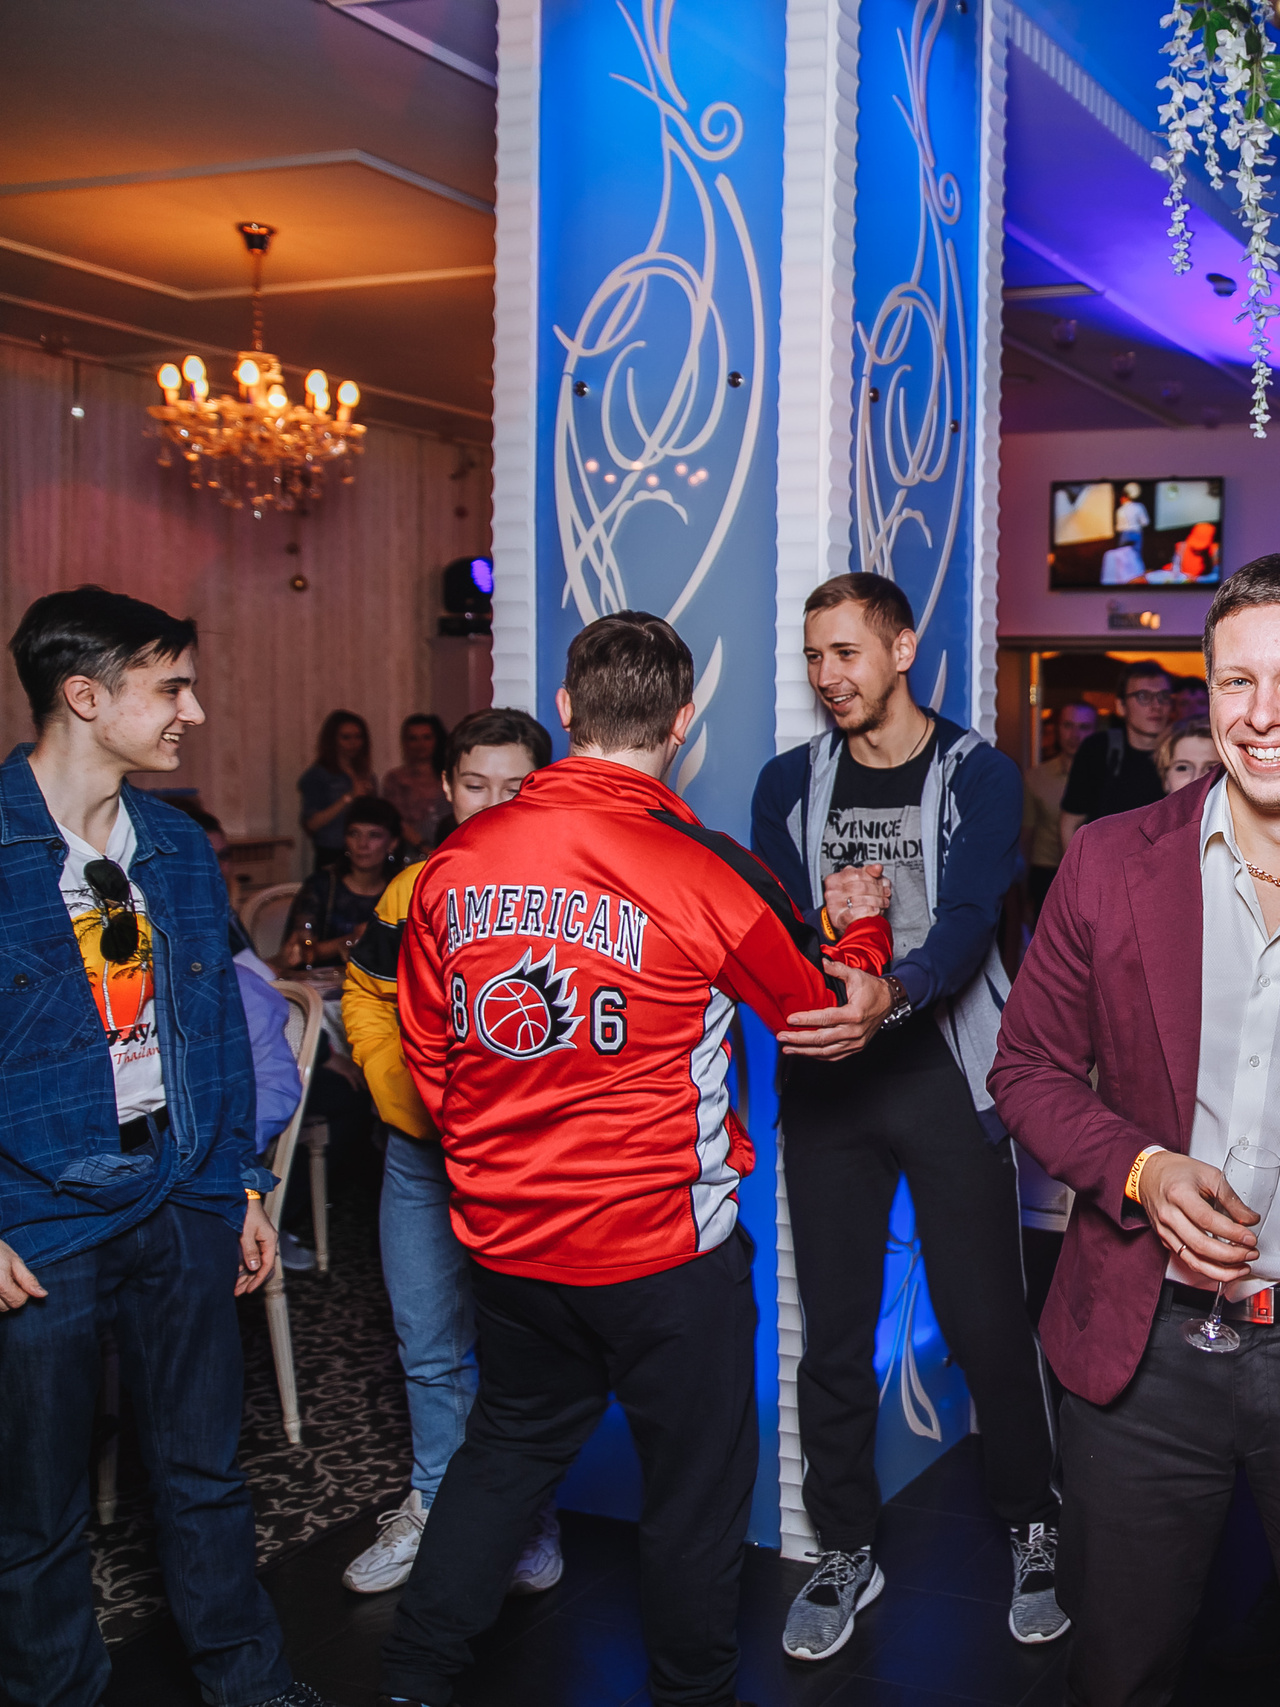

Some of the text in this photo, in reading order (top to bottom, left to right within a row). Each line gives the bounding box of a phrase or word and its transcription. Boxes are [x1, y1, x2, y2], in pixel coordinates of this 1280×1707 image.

[833, 819, 902, 839] VENICE
[820, 839, 924, 861] ROMENAD
[447, 884, 648, 973] AMERICAN
[450, 972, 628, 1056] 8 6
[113, 1045, 160, 1065] Thailan
